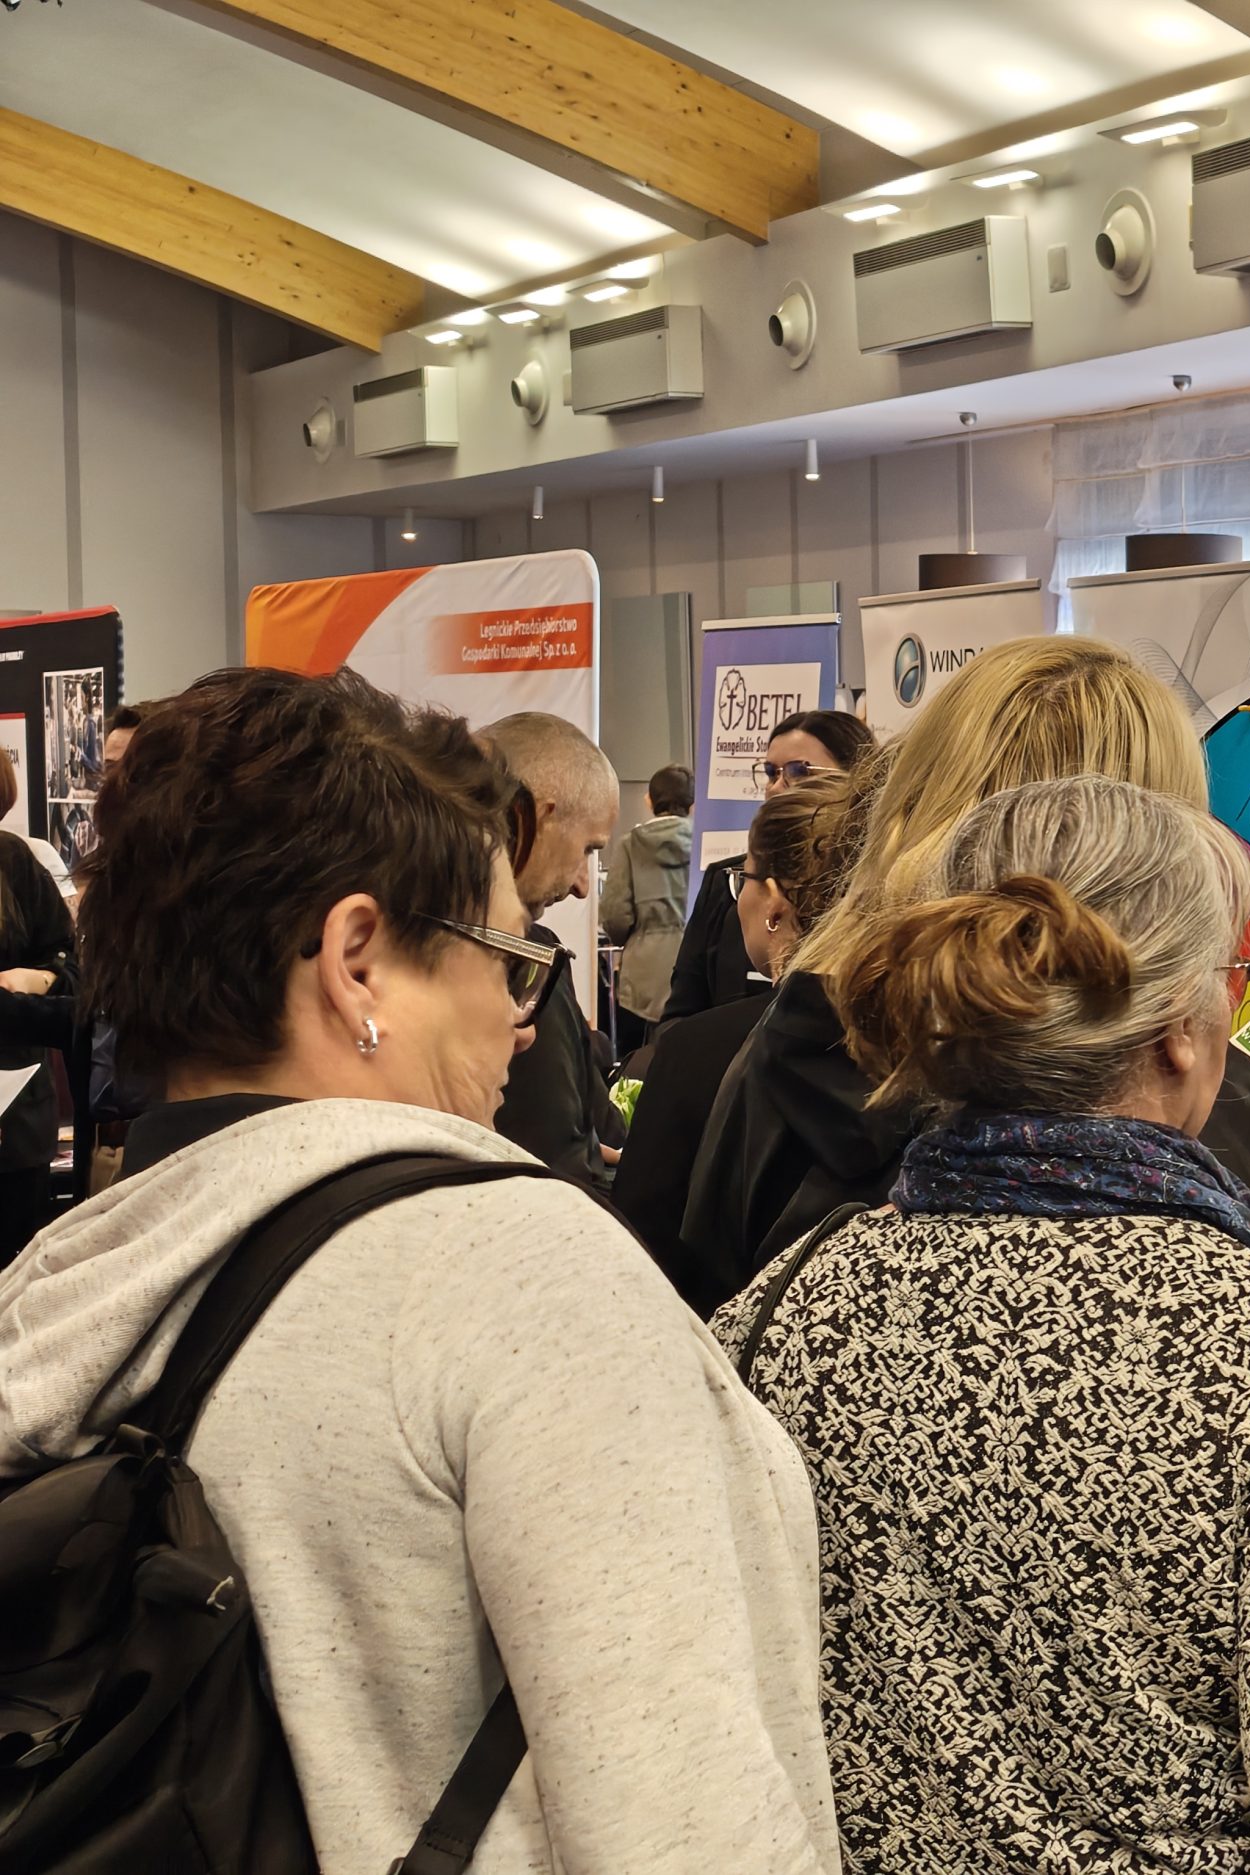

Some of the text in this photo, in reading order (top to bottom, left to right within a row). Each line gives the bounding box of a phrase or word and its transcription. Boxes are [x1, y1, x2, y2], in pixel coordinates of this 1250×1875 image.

[480, 617, 577, 640] Legnickie Przedsiębiorstwo
[462, 644, 500, 664] Gospodarki
[501, 640, 543, 660] Komunalnej
[929, 646, 984, 673] WIND
